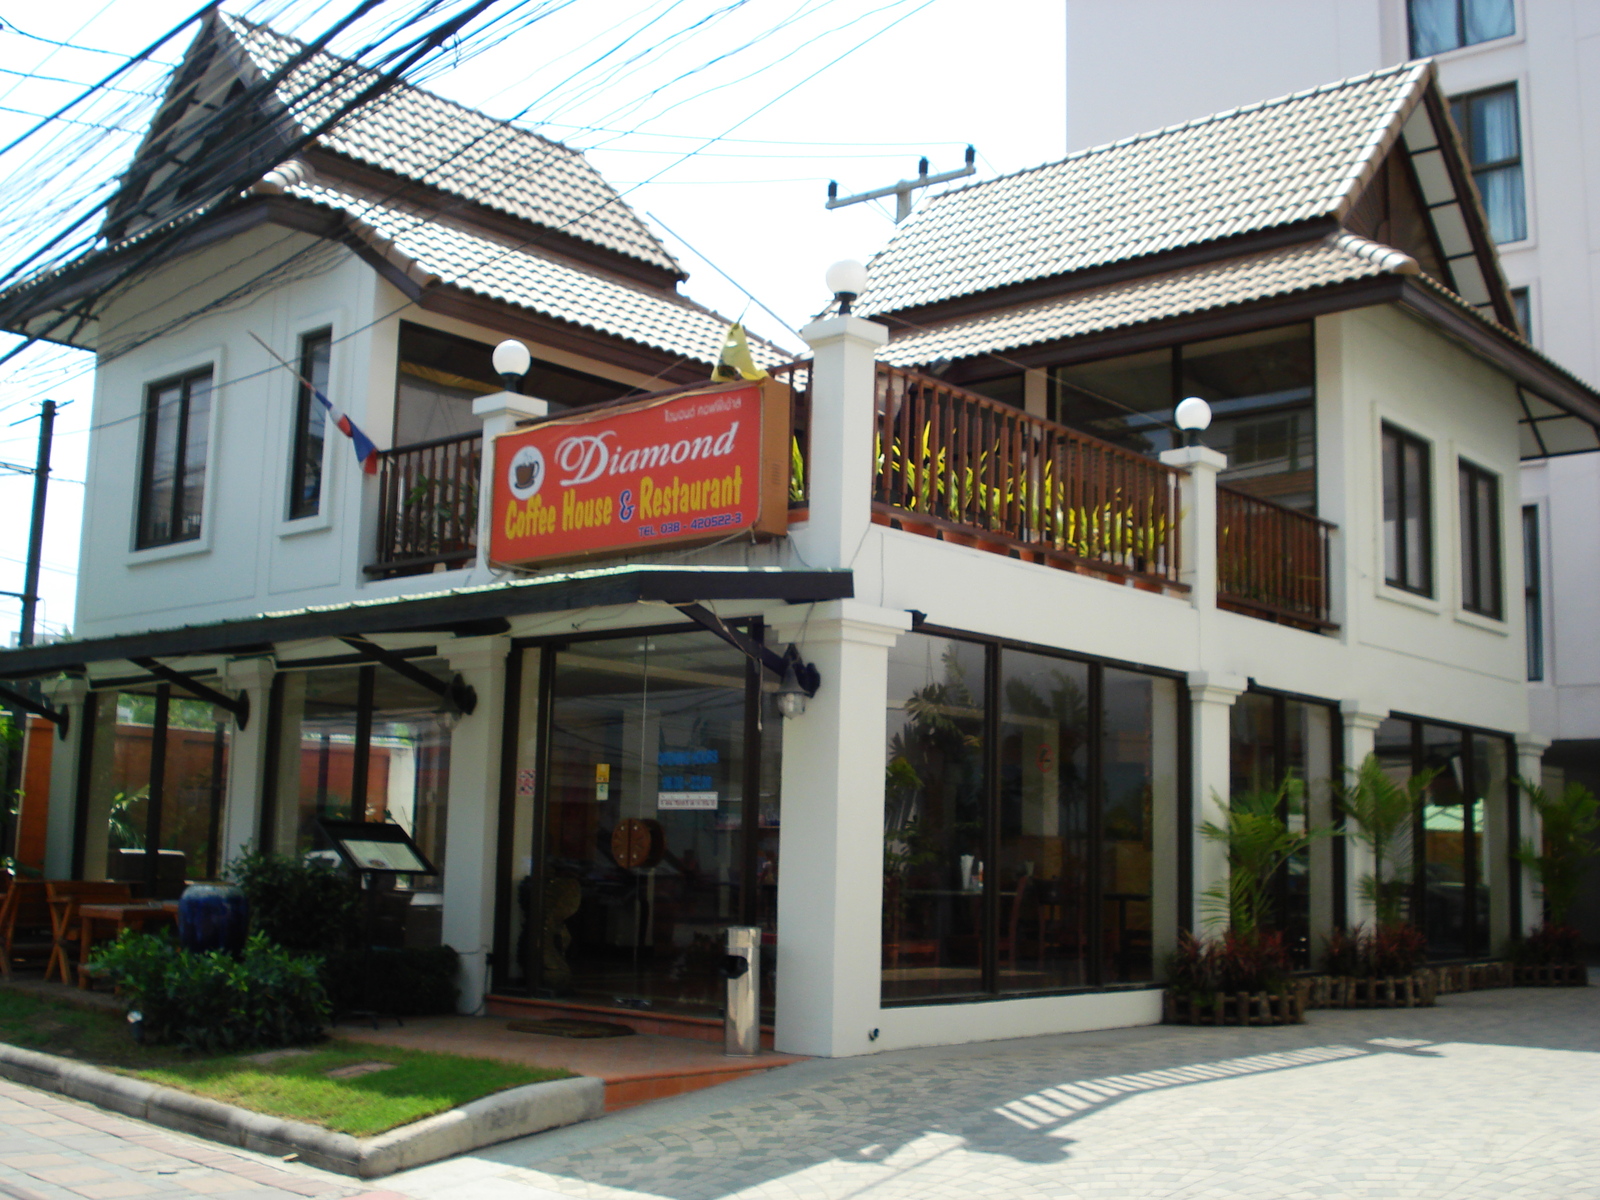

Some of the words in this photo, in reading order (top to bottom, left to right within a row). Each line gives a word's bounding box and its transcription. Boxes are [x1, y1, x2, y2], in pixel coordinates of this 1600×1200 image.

[554, 421, 740, 487] Diamond
[505, 494, 556, 540] Coffee
[562, 488, 613, 532] House
[619, 489, 635, 524] &
[638, 465, 743, 520] Restaurant
[660, 521, 681, 534] 038
[689, 512, 743, 530] 420522-3
